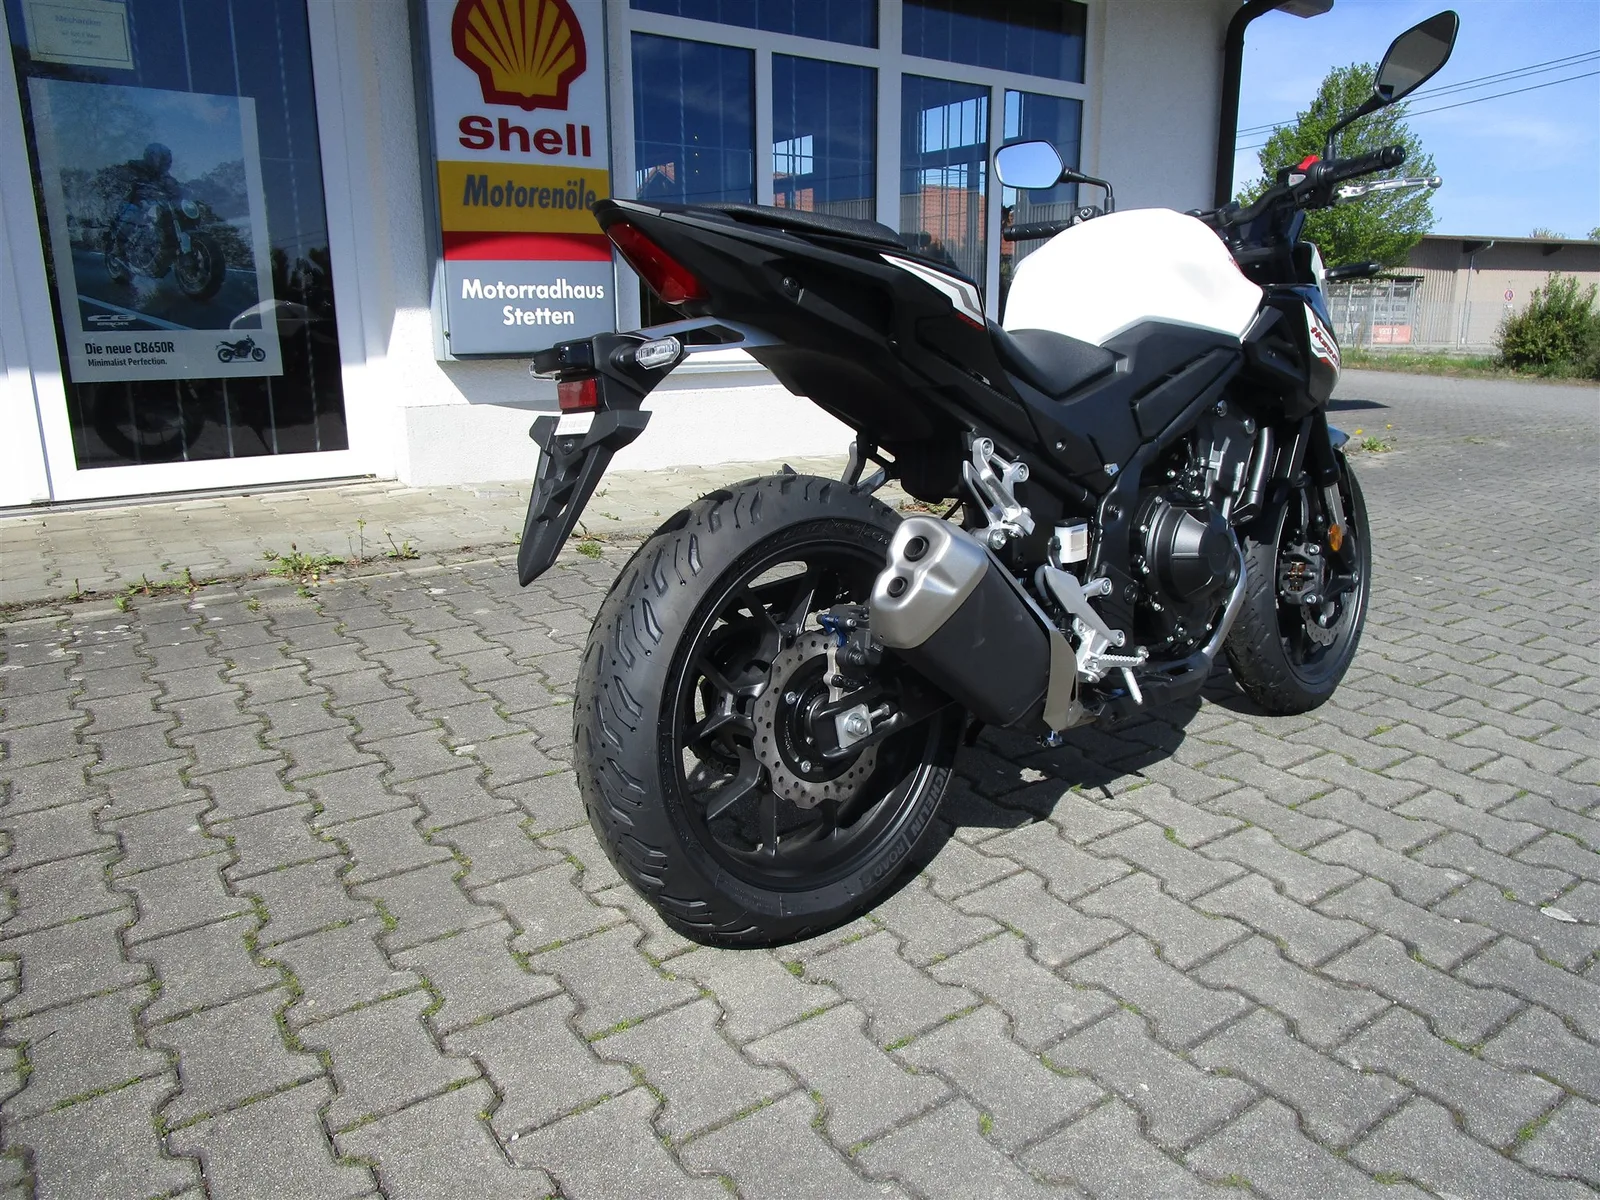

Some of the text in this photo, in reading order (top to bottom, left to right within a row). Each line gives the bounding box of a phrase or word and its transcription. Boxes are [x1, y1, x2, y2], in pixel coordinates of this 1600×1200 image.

[458, 115, 592, 157] Shell
[463, 174, 597, 211] Motorenöle
[461, 278, 605, 299] Motorradhaus
[502, 305, 575, 326] Stetten
[84, 341, 175, 355] Die neue CB650R
[88, 357, 168, 367] Minimalist Perfection.
[910, 767, 948, 836] ICHELIN
